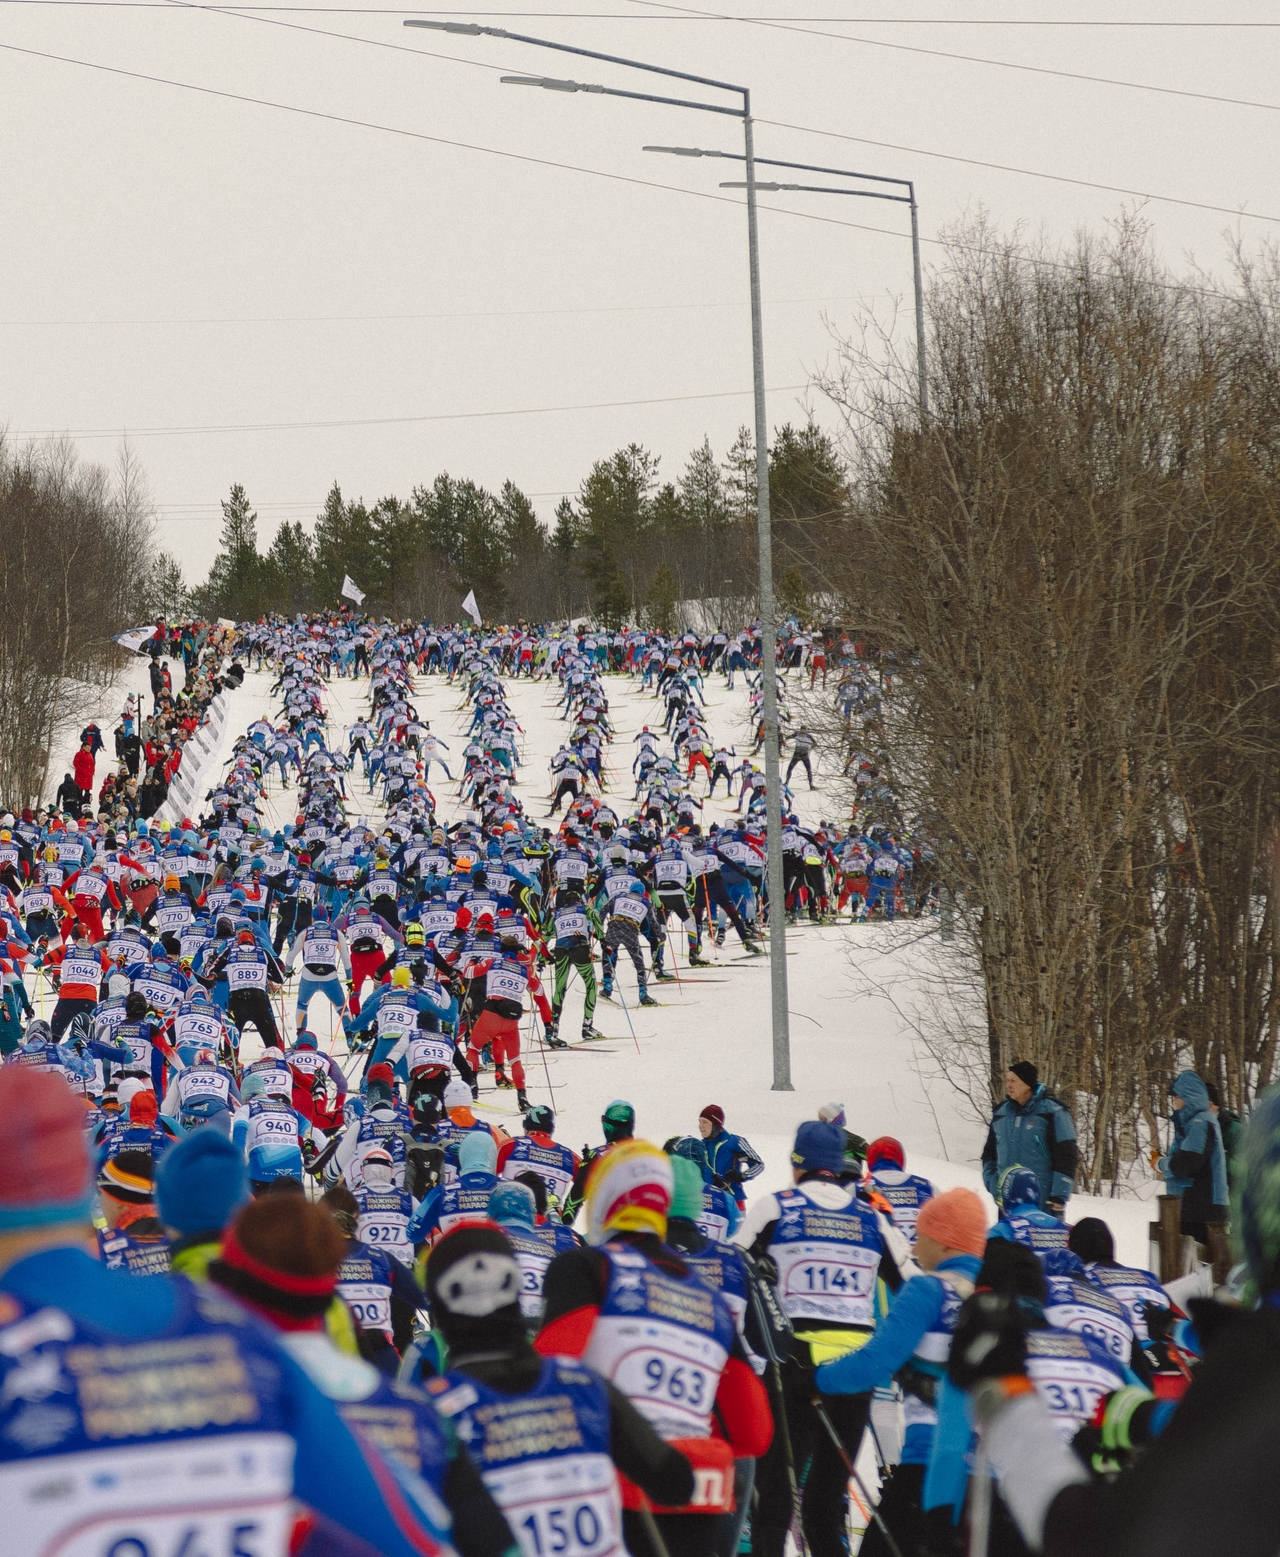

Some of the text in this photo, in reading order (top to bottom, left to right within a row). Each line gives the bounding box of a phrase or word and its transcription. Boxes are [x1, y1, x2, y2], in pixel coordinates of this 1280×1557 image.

[624, 903, 637, 911] 816
[72, 967, 94, 975] 1044
[239, 971, 256, 979] 889
[501, 979, 518, 988] 695
[146, 989, 166, 1001] 966
[190, 1022, 212, 1033] 765
[424, 1048, 443, 1058] 613
[266, 1121, 291, 1132] 940
[529, 1150, 562, 1161] ЛЫЖНЫЙ
[529, 1155, 562, 1167] МАРАФОН
[806, 1218, 862, 1232] ЛЫЖНЫЙ
[370, 1227, 400, 1242] 927
[806, 1227, 863, 1241] МАРАФОН
[805, 1266, 860, 1292] 1141
[646, 1358, 706, 1406] 963
[522, 1506, 600, 1556] 150
